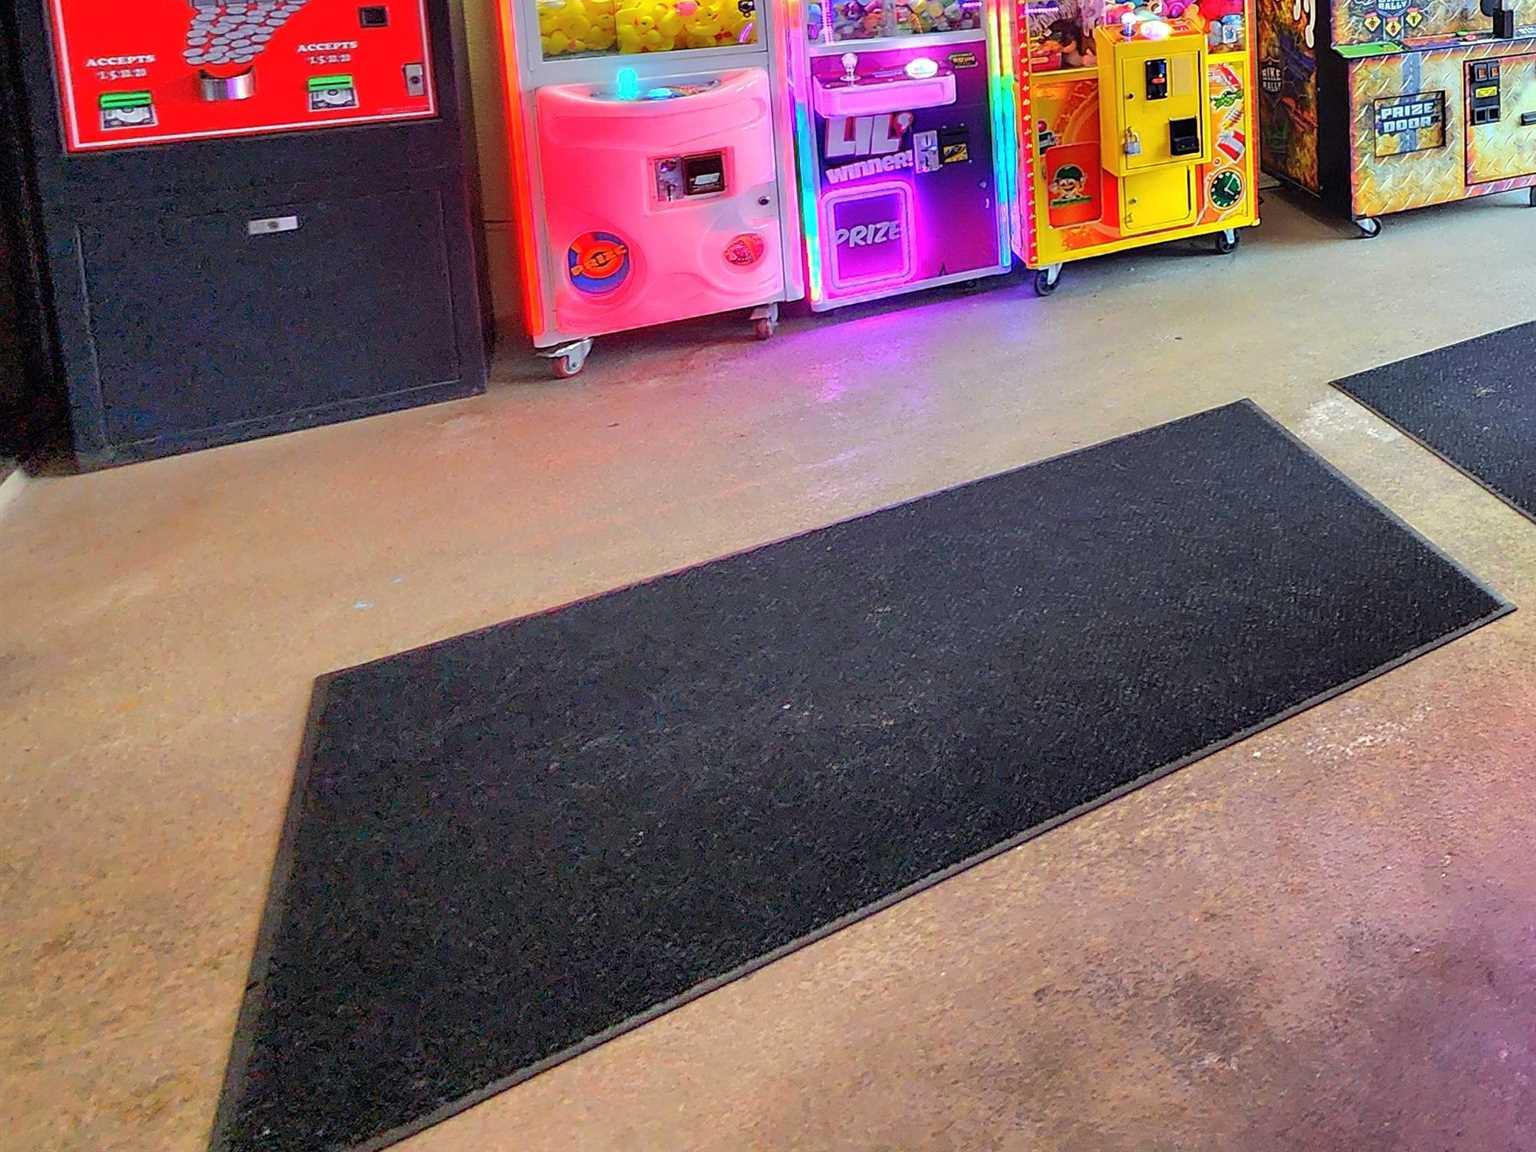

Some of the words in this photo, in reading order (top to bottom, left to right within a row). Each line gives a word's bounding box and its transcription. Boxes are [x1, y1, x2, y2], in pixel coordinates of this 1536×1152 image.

[1378, 1, 1408, 10] RALLY
[297, 40, 358, 53] ACCEPTS
[85, 54, 156, 67] ACCEPTS
[1381, 102, 1434, 120] PRIZE
[1383, 116, 1432, 133] DOOR
[833, 220, 901, 247] PRIZE
